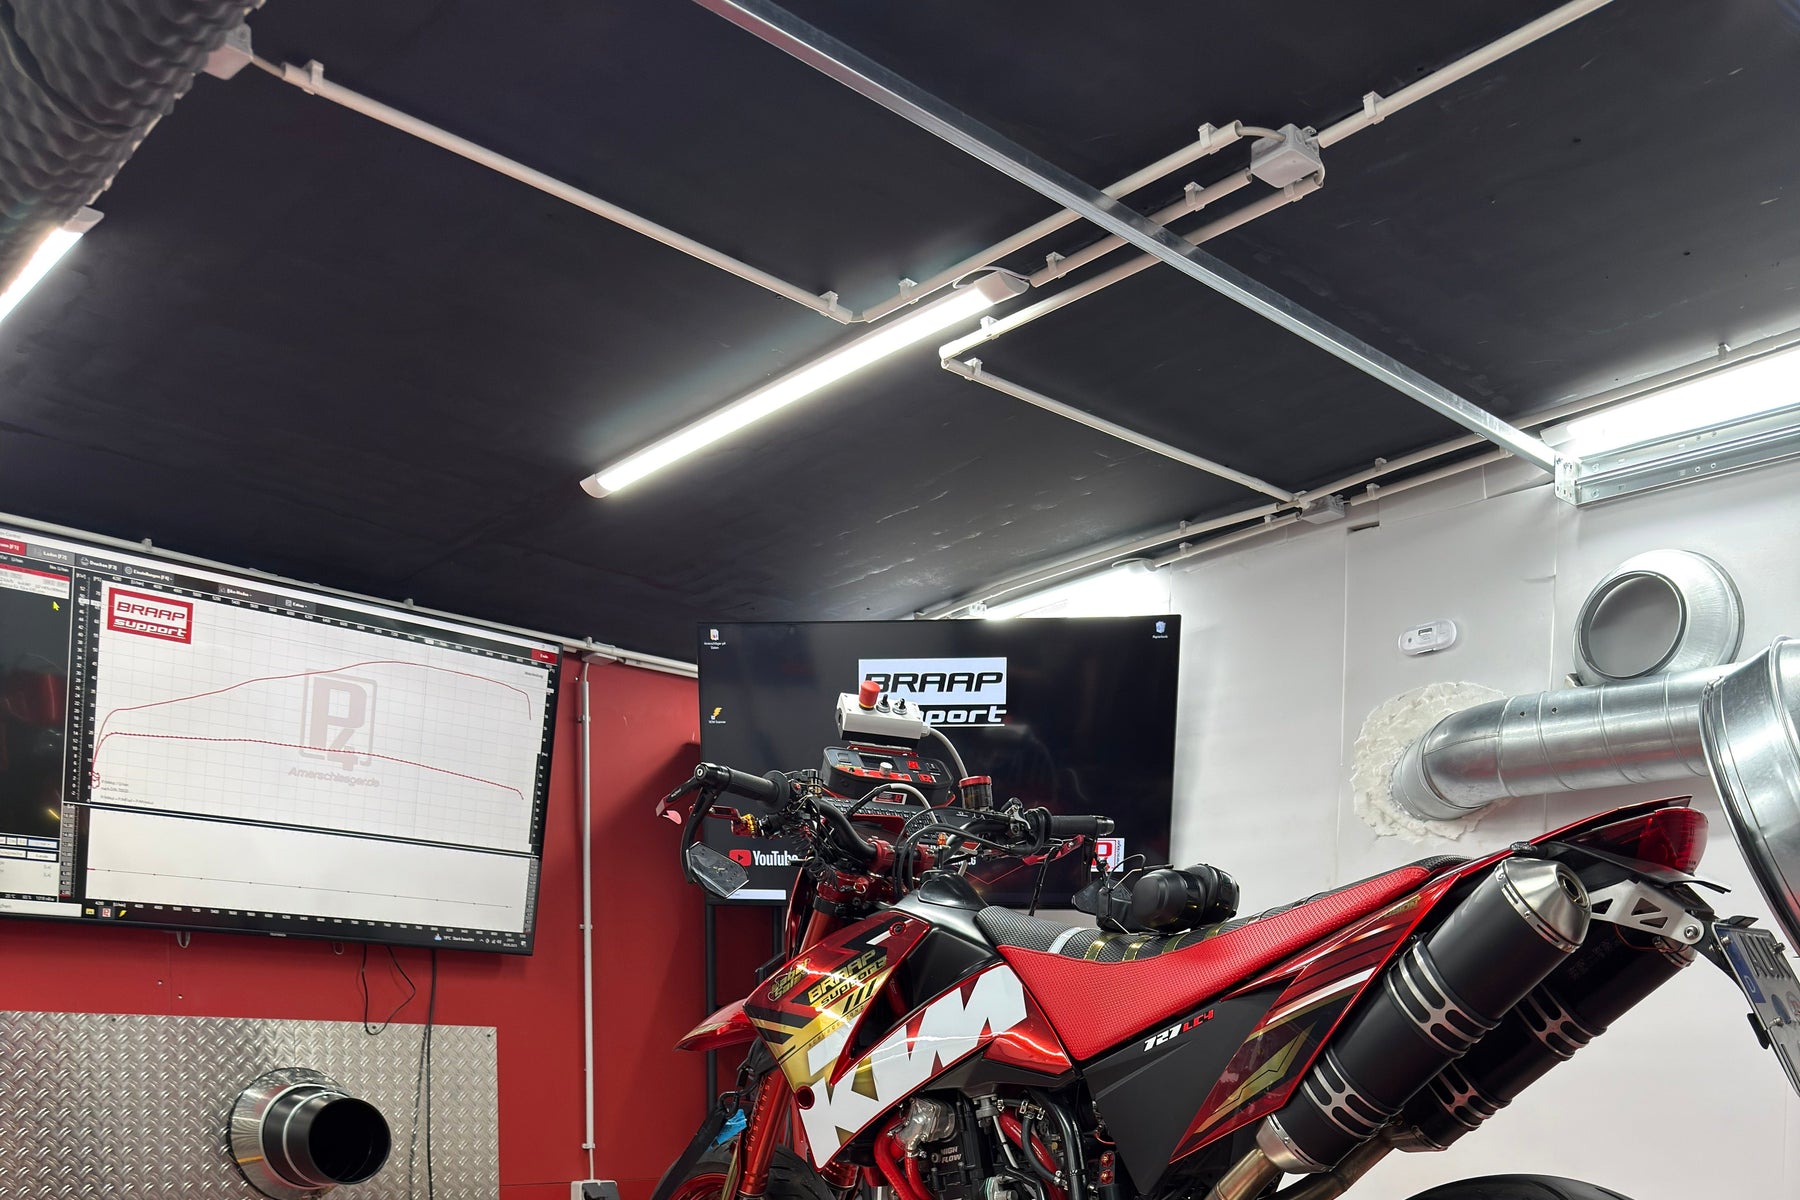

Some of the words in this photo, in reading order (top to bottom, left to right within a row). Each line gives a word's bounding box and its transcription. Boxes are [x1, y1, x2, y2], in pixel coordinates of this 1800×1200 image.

[117, 601, 186, 622] BRAAP
[114, 618, 187, 638] support
[865, 671, 1004, 693] BRAAP
[918, 705, 1008, 724] port
[808, 949, 877, 1004] BRAAP
[1744, 975, 1755, 993] D
[1143, 1024, 1182, 1052] 727
[1182, 1009, 1215, 1032] LC4
[798, 964, 1028, 1169] KTM
[941, 1145, 959, 1155] HIGH
[941, 1154, 962, 1164] FLOW
